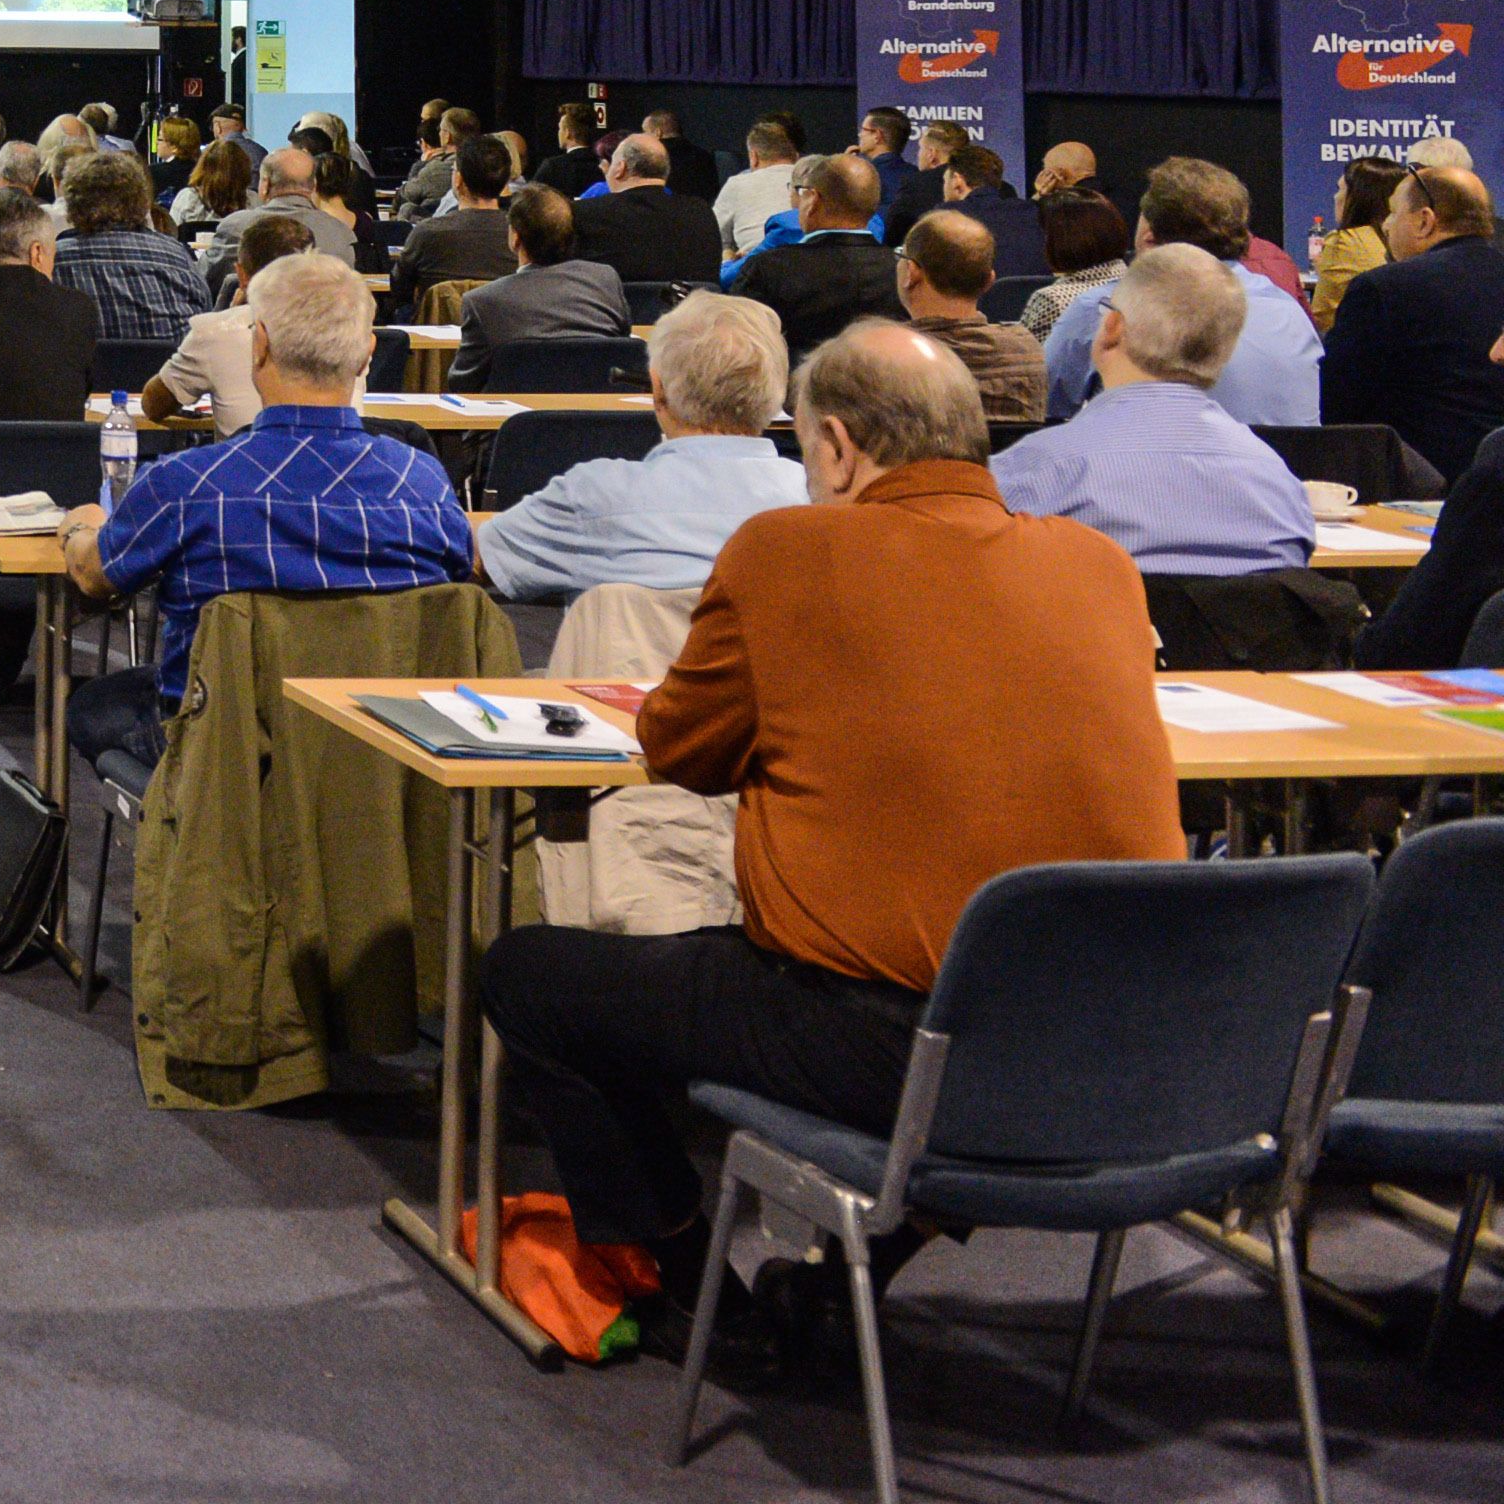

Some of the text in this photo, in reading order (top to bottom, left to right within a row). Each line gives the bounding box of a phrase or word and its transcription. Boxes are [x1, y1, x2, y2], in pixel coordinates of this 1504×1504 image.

[908, 0, 995, 12] Brandenburg
[879, 38, 986, 54] Alternative
[1312, 33, 1455, 53] Alternative
[922, 68, 987, 78] Deutschland
[1368, 62, 1384, 72] für
[1368, 72, 1456, 84] Deutschland
[1329, 114, 1455, 139] IDENTITÄT
